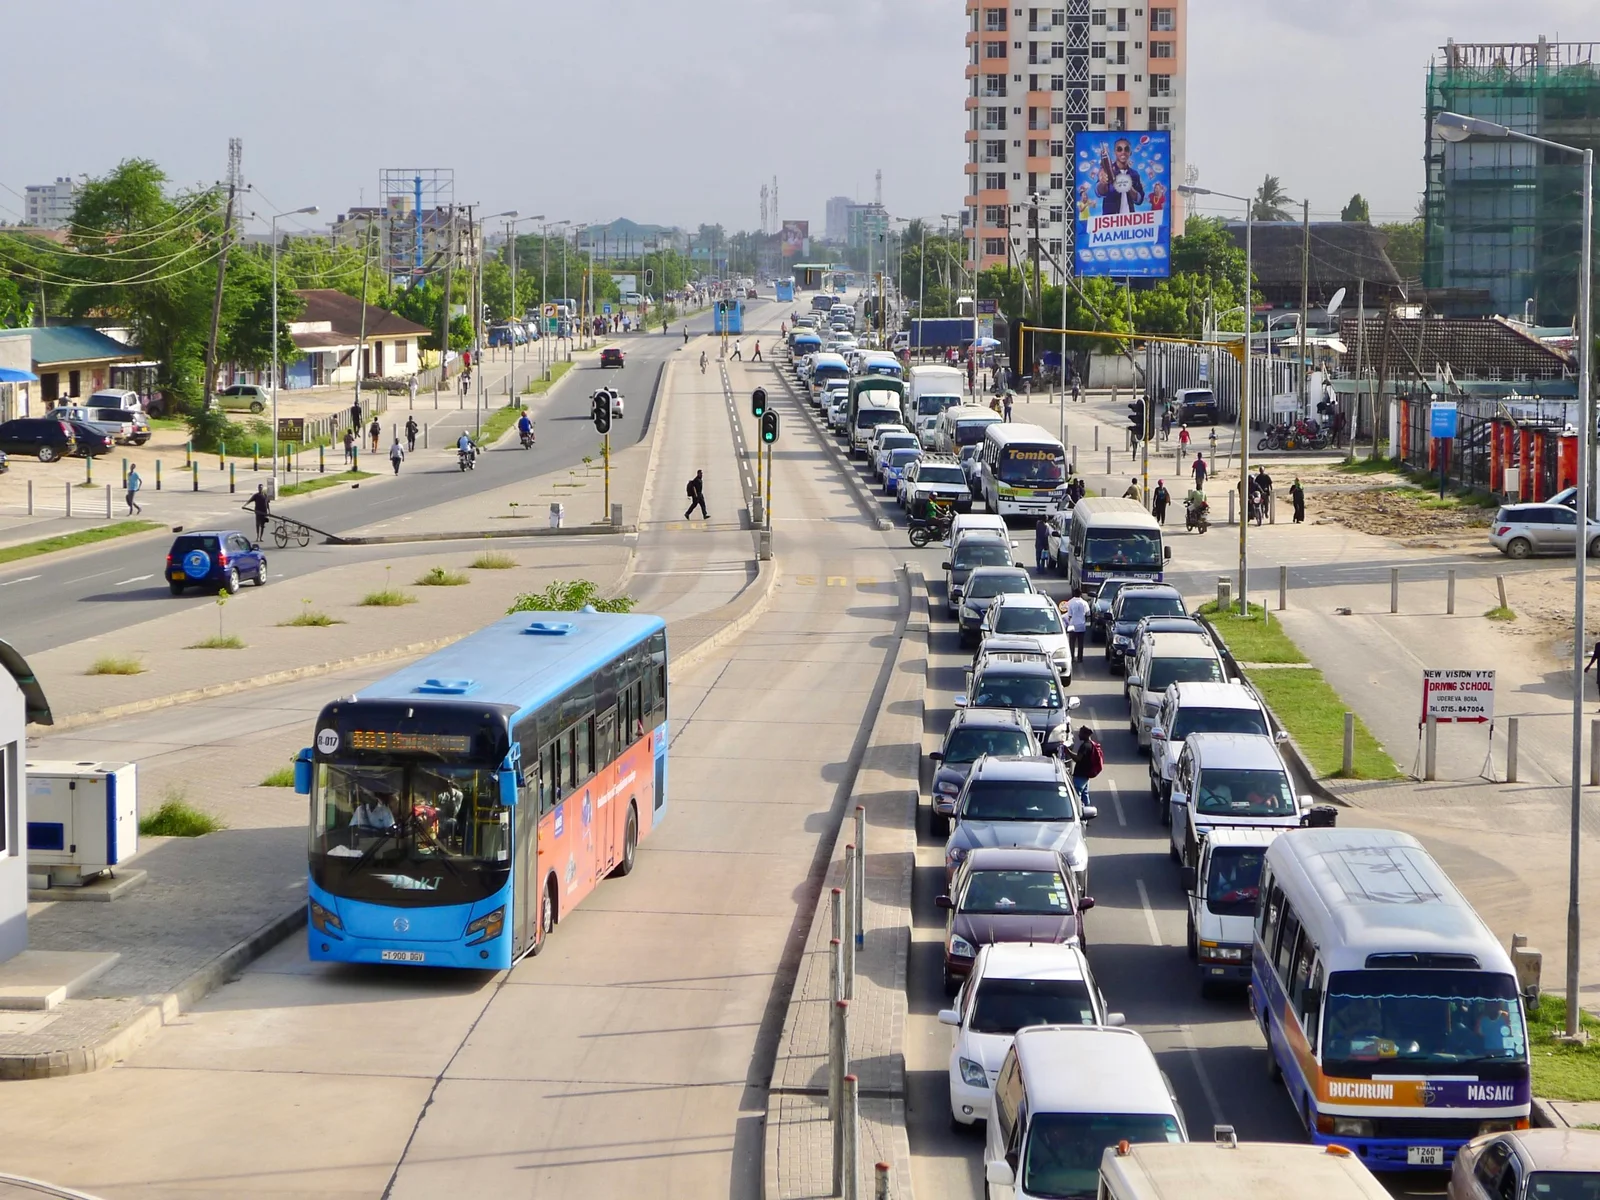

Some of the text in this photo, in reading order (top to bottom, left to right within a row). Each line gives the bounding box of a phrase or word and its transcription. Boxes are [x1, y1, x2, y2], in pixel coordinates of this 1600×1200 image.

[1092, 212, 1155, 233] JISHINDIE
[1092, 228, 1154, 243] MAMILIONI
[1008, 449, 1056, 460] Tembo
[1429, 682, 1494, 691] DRIVING SCHOOL
[392, 952, 407, 960] 900
[1329, 1081, 1393, 1099] BUGURUNI
[1467, 1085, 1514, 1101] MASAKI
[1420, 1156, 1435, 1164] AWQ
